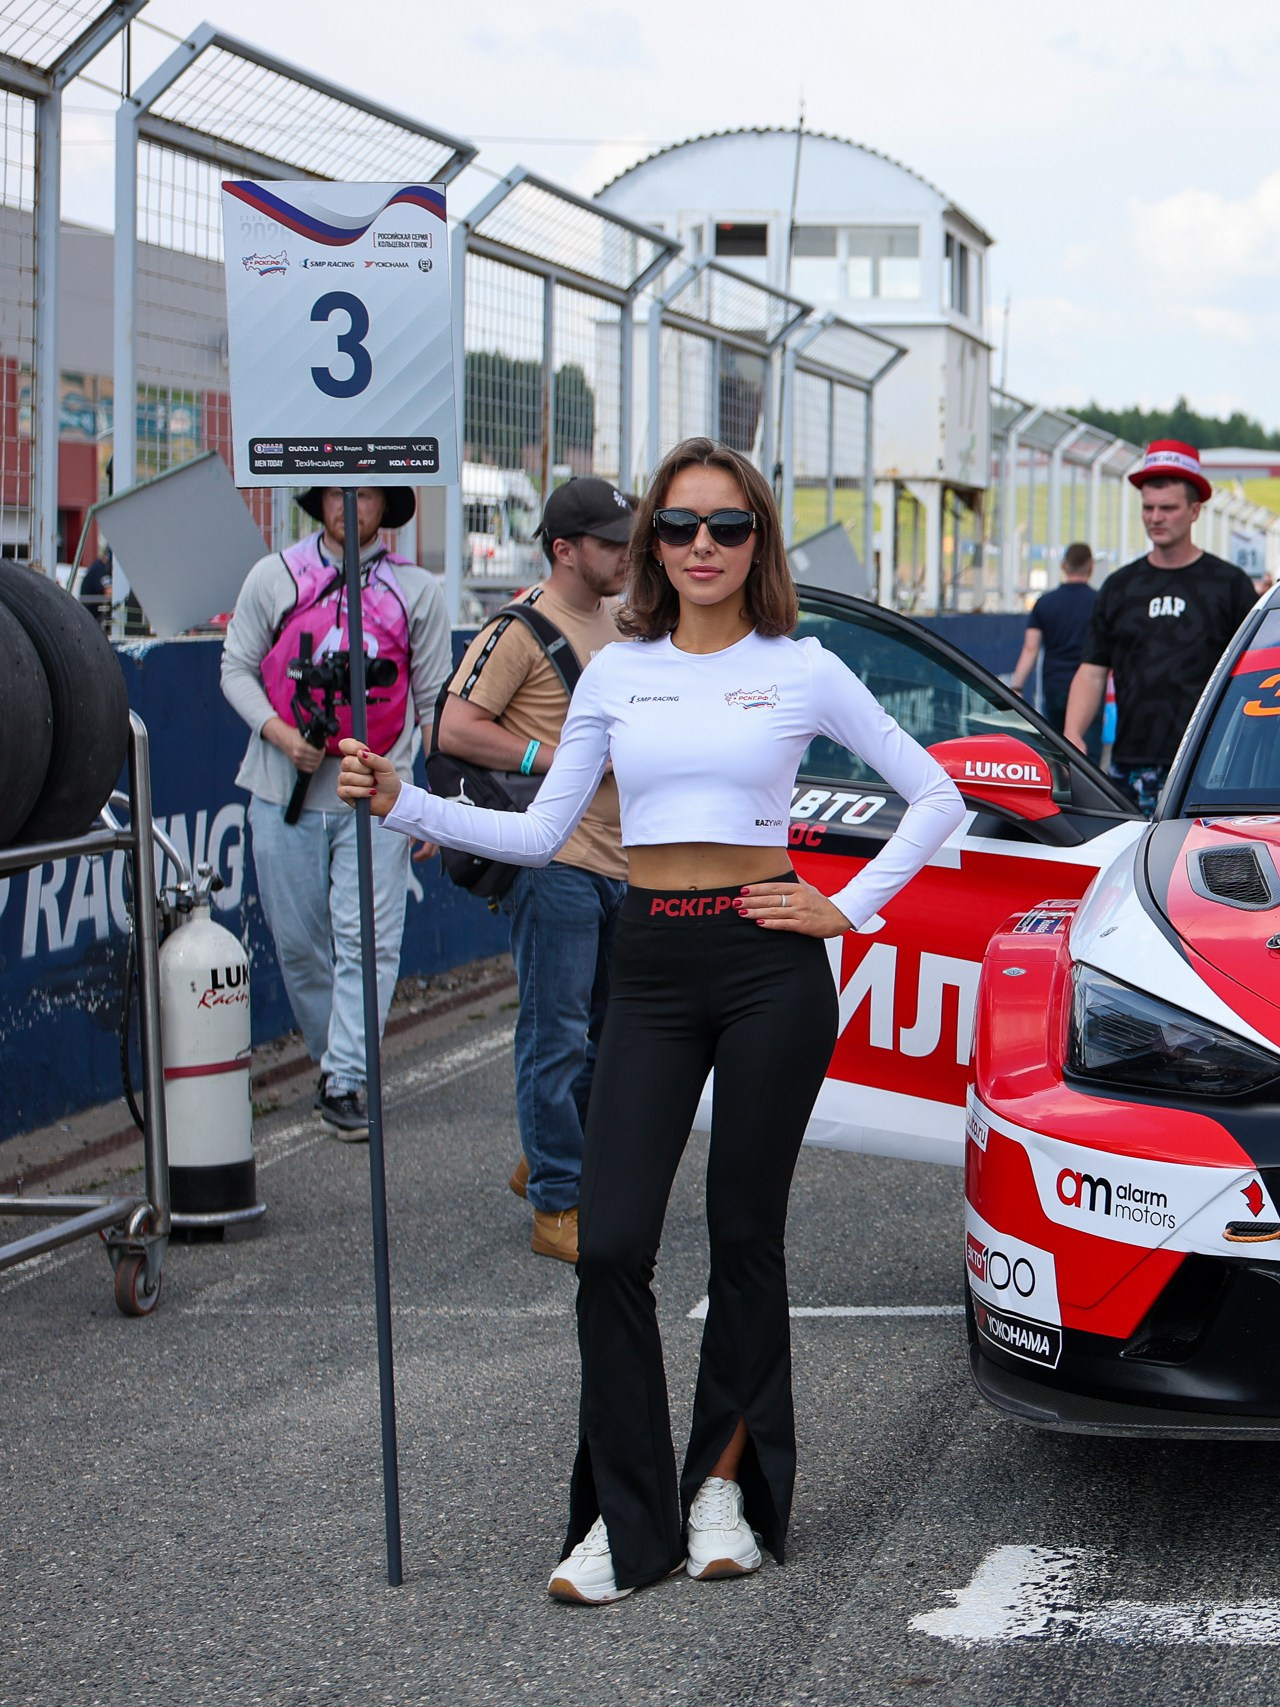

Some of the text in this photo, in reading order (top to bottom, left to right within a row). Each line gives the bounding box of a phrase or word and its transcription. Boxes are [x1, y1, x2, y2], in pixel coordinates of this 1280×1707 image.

[310, 291, 373, 399] 3
[412, 444, 434, 452] VOICE
[294, 459, 345, 468] ТехИнсайдер
[1149, 596, 1186, 618] GAP
[964, 760, 1042, 782] LUKOIL
[650, 896, 732, 916] РСКГ.Р
[1056, 1167, 1112, 1216] am
[1116, 1183, 1167, 1208] alarm
[1115, 1203, 1176, 1229] motors
[986, 1313, 1050, 1356] YOKOHAMA
